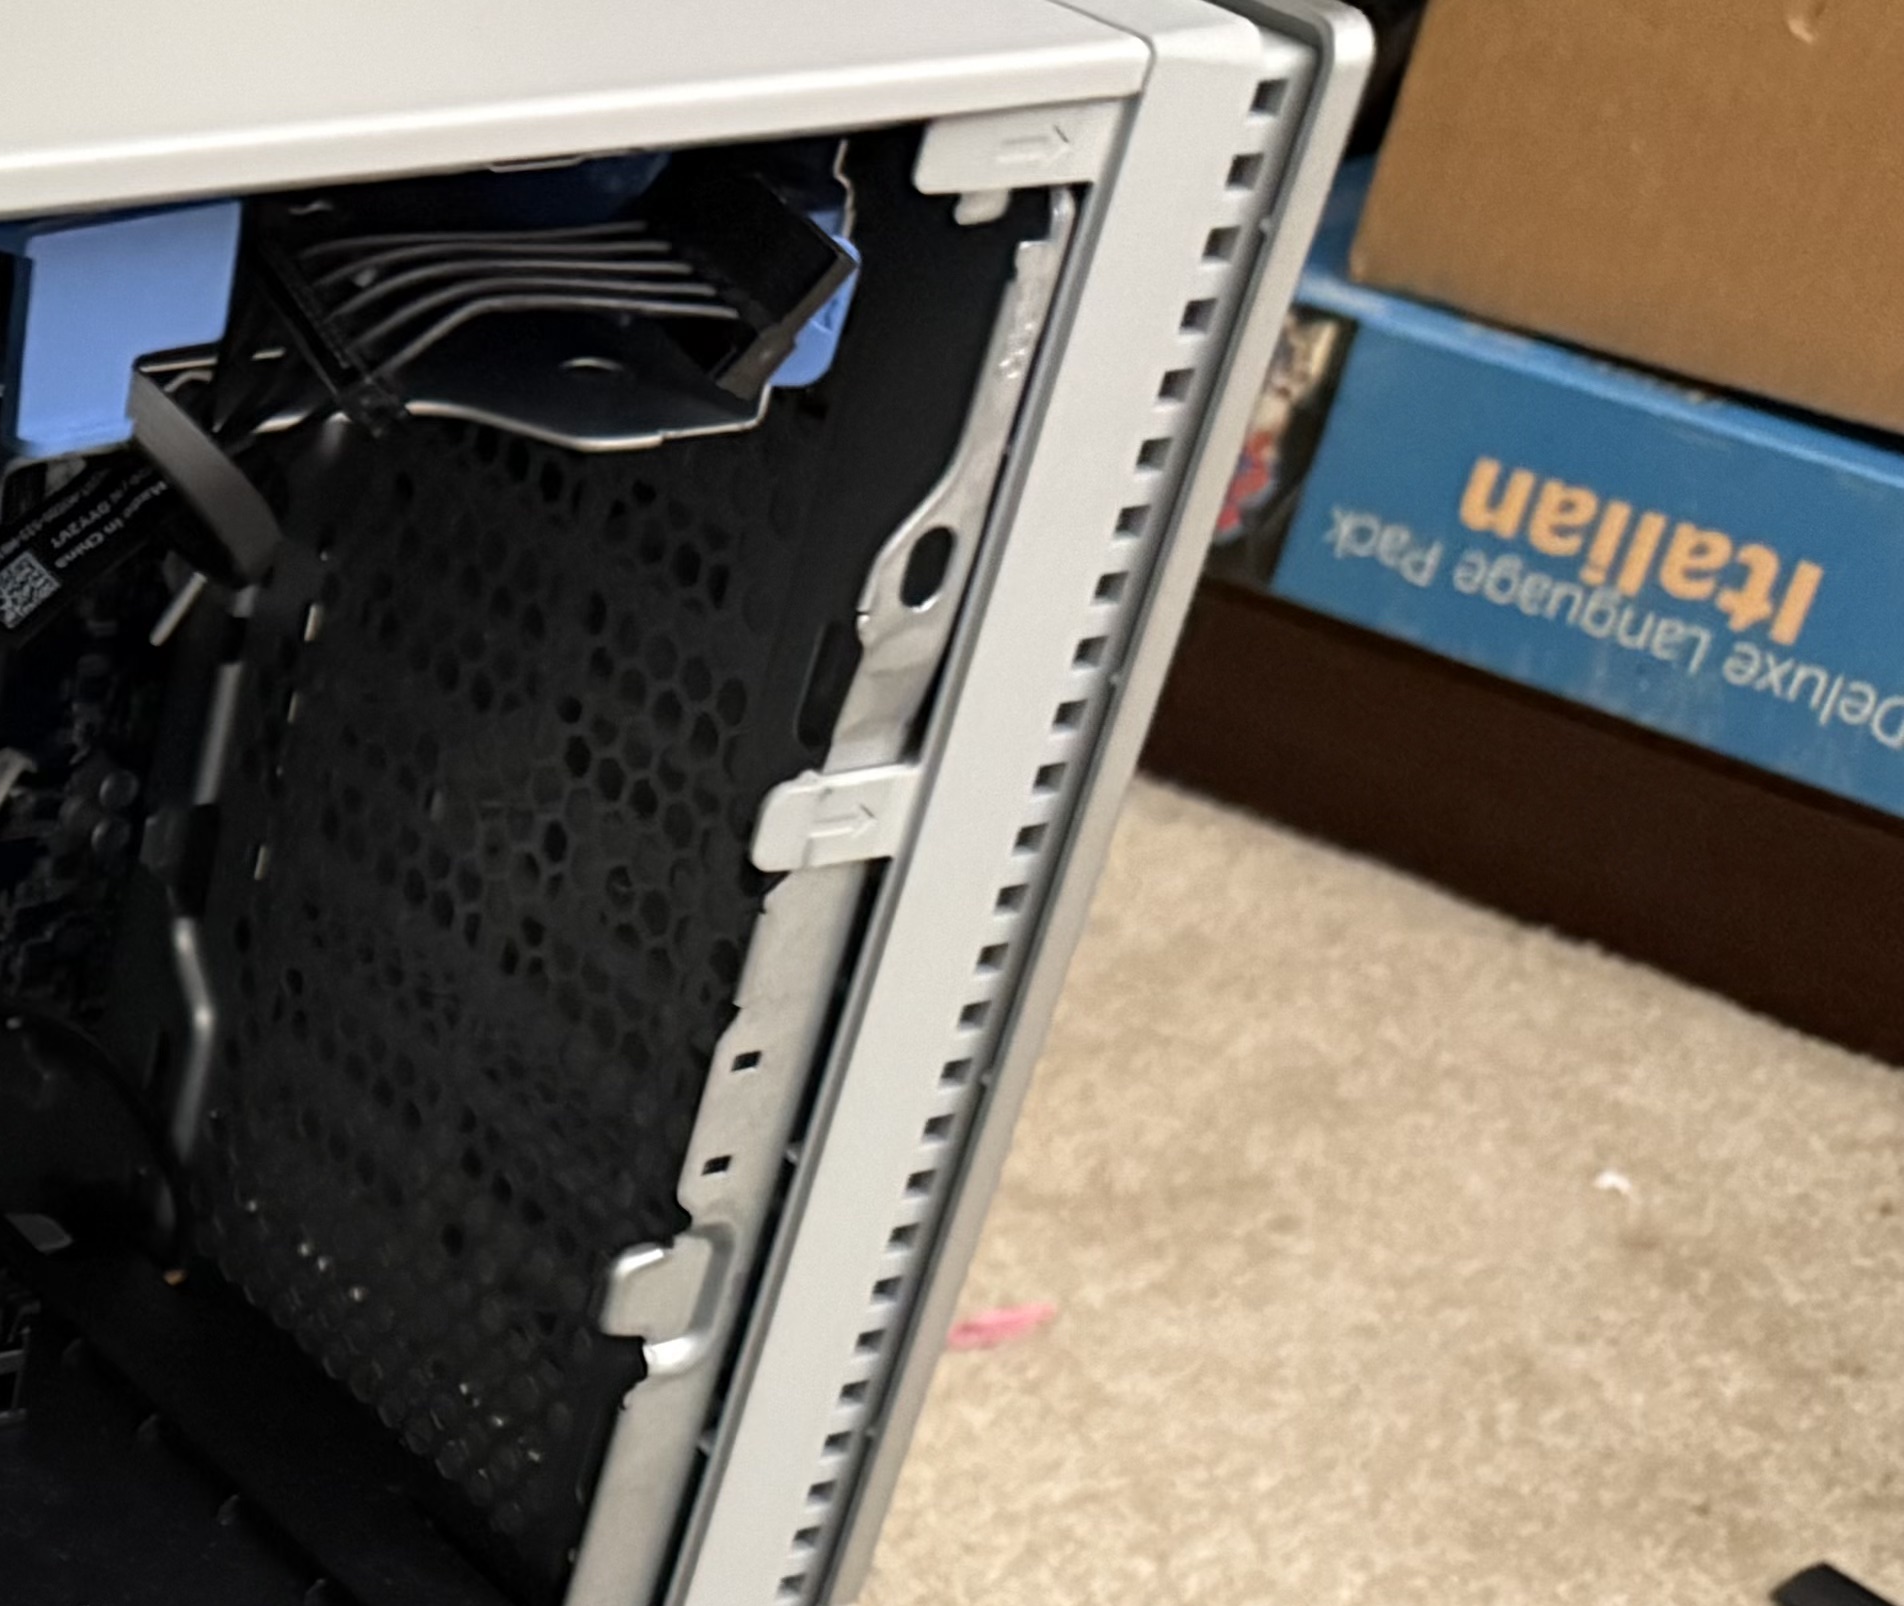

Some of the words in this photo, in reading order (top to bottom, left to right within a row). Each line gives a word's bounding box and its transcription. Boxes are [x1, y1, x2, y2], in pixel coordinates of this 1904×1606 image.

[53, 532, 106, 570] China
[1323, 506, 1441, 588] Pack
[1459, 457, 1824, 645] Italian
[1453, 550, 1713, 672] Language
[1721, 640, 1904, 748] Deluxe
